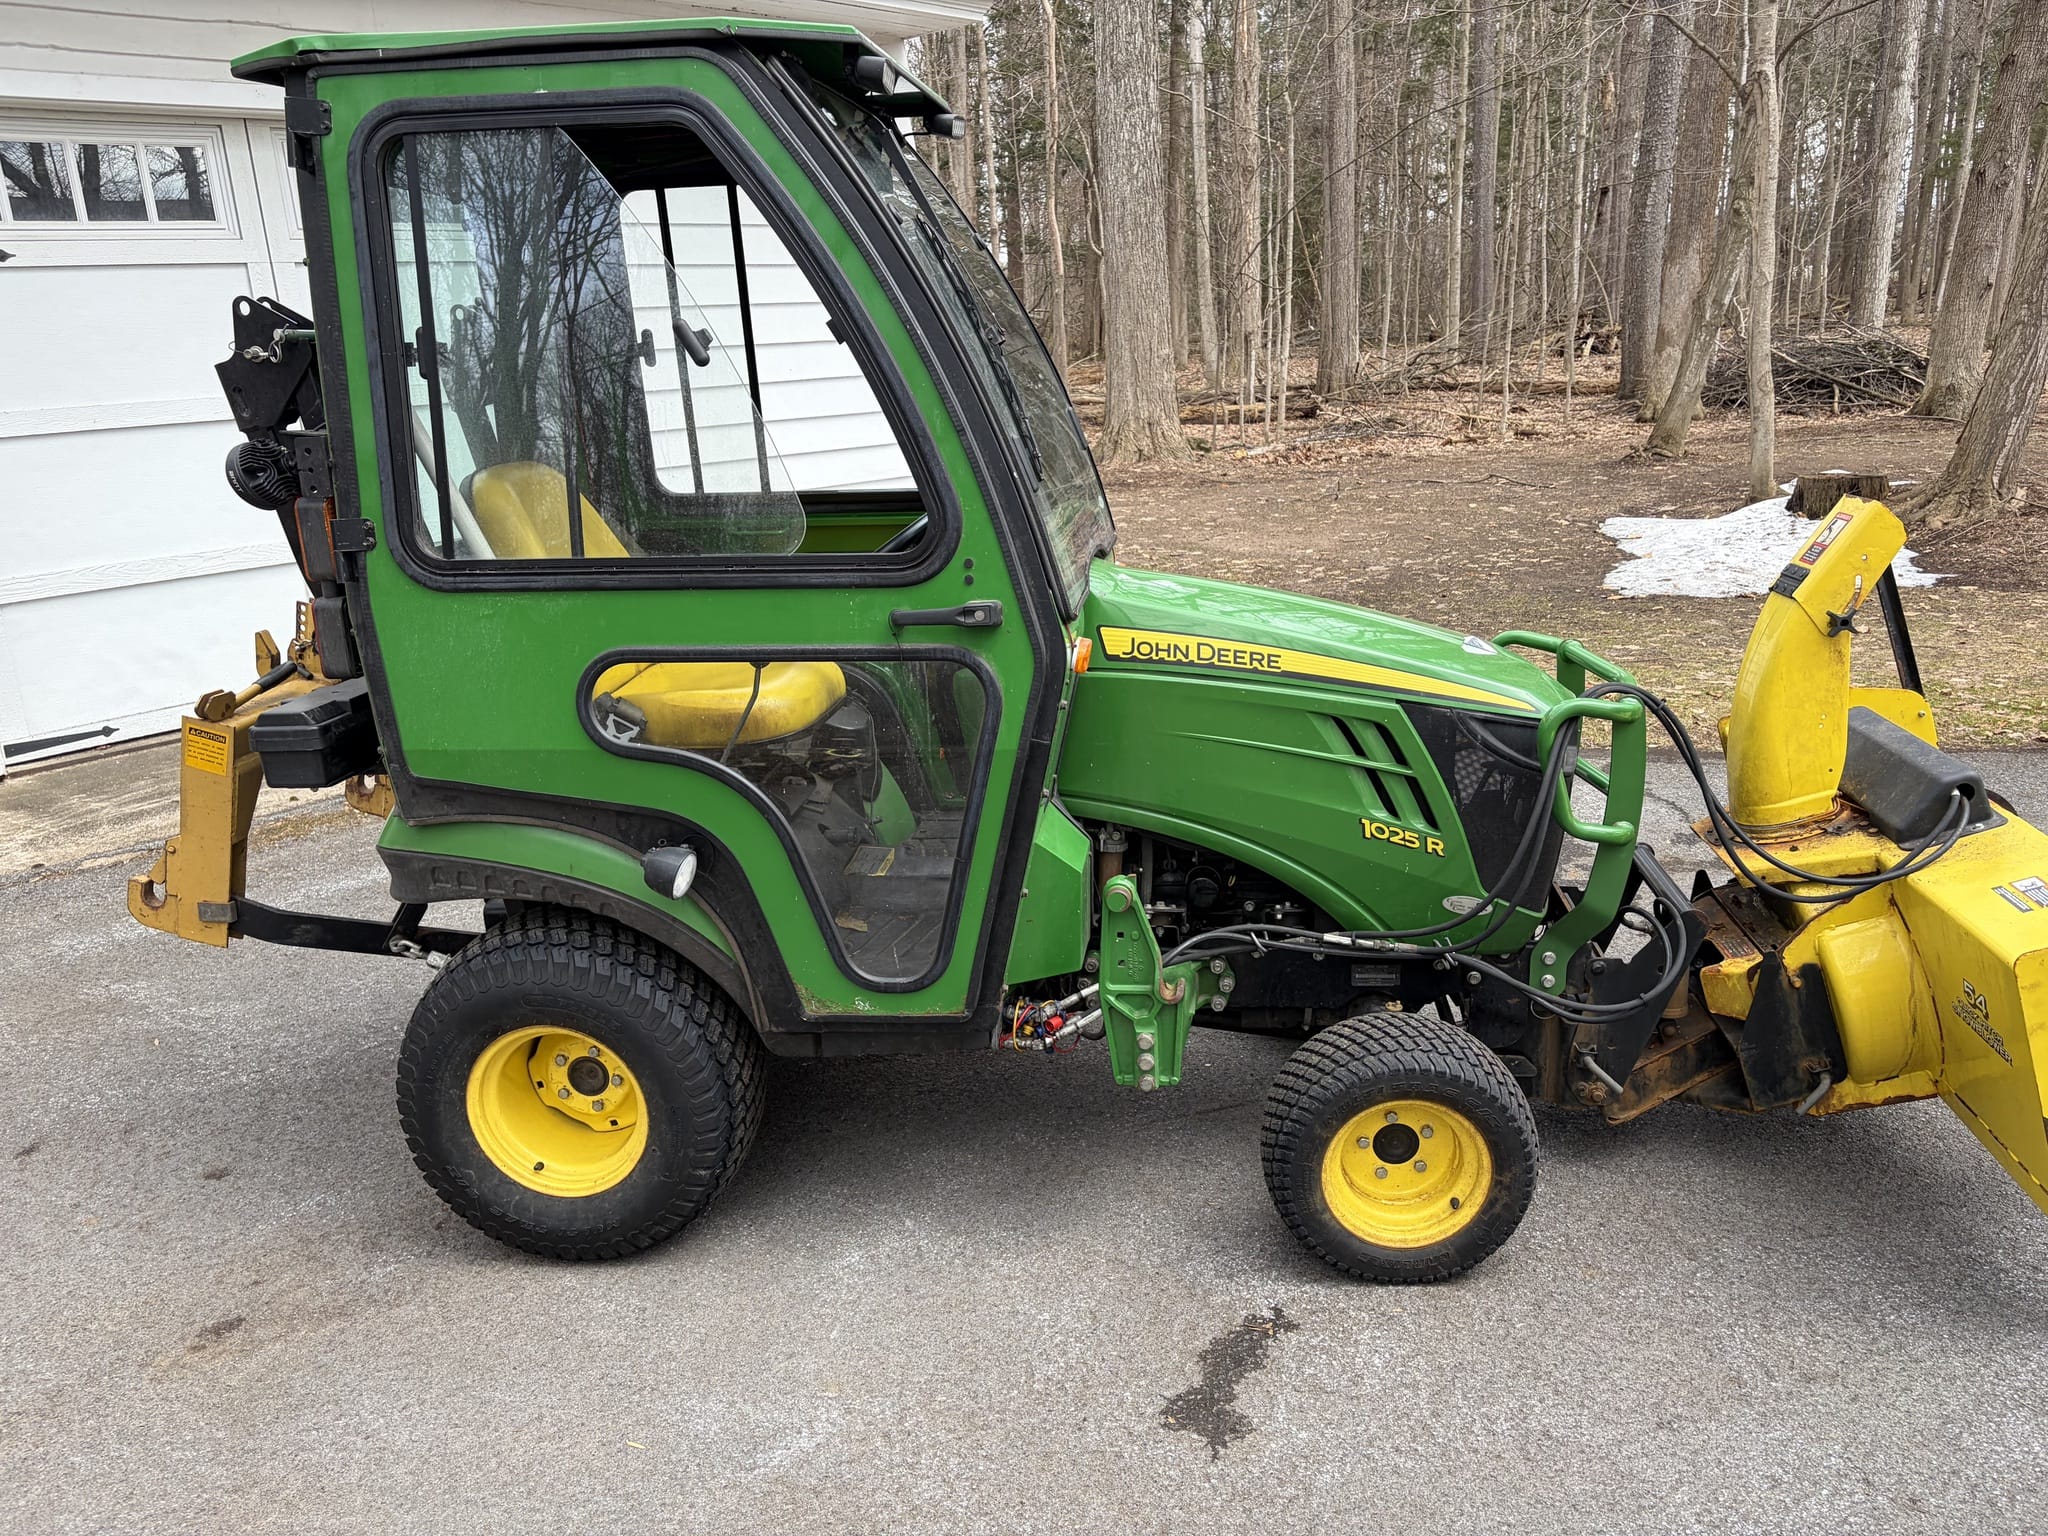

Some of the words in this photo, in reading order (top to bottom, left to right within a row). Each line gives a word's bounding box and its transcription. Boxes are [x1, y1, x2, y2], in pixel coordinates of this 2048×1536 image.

[1122, 637, 1190, 661] JOHN
[1196, 642, 1282, 670] DEERE
[196, 729, 226, 743] CAUTION
[1361, 818, 1420, 849] 1025
[1426, 836, 1445, 857] R
[1963, 977, 1989, 1021] 54
